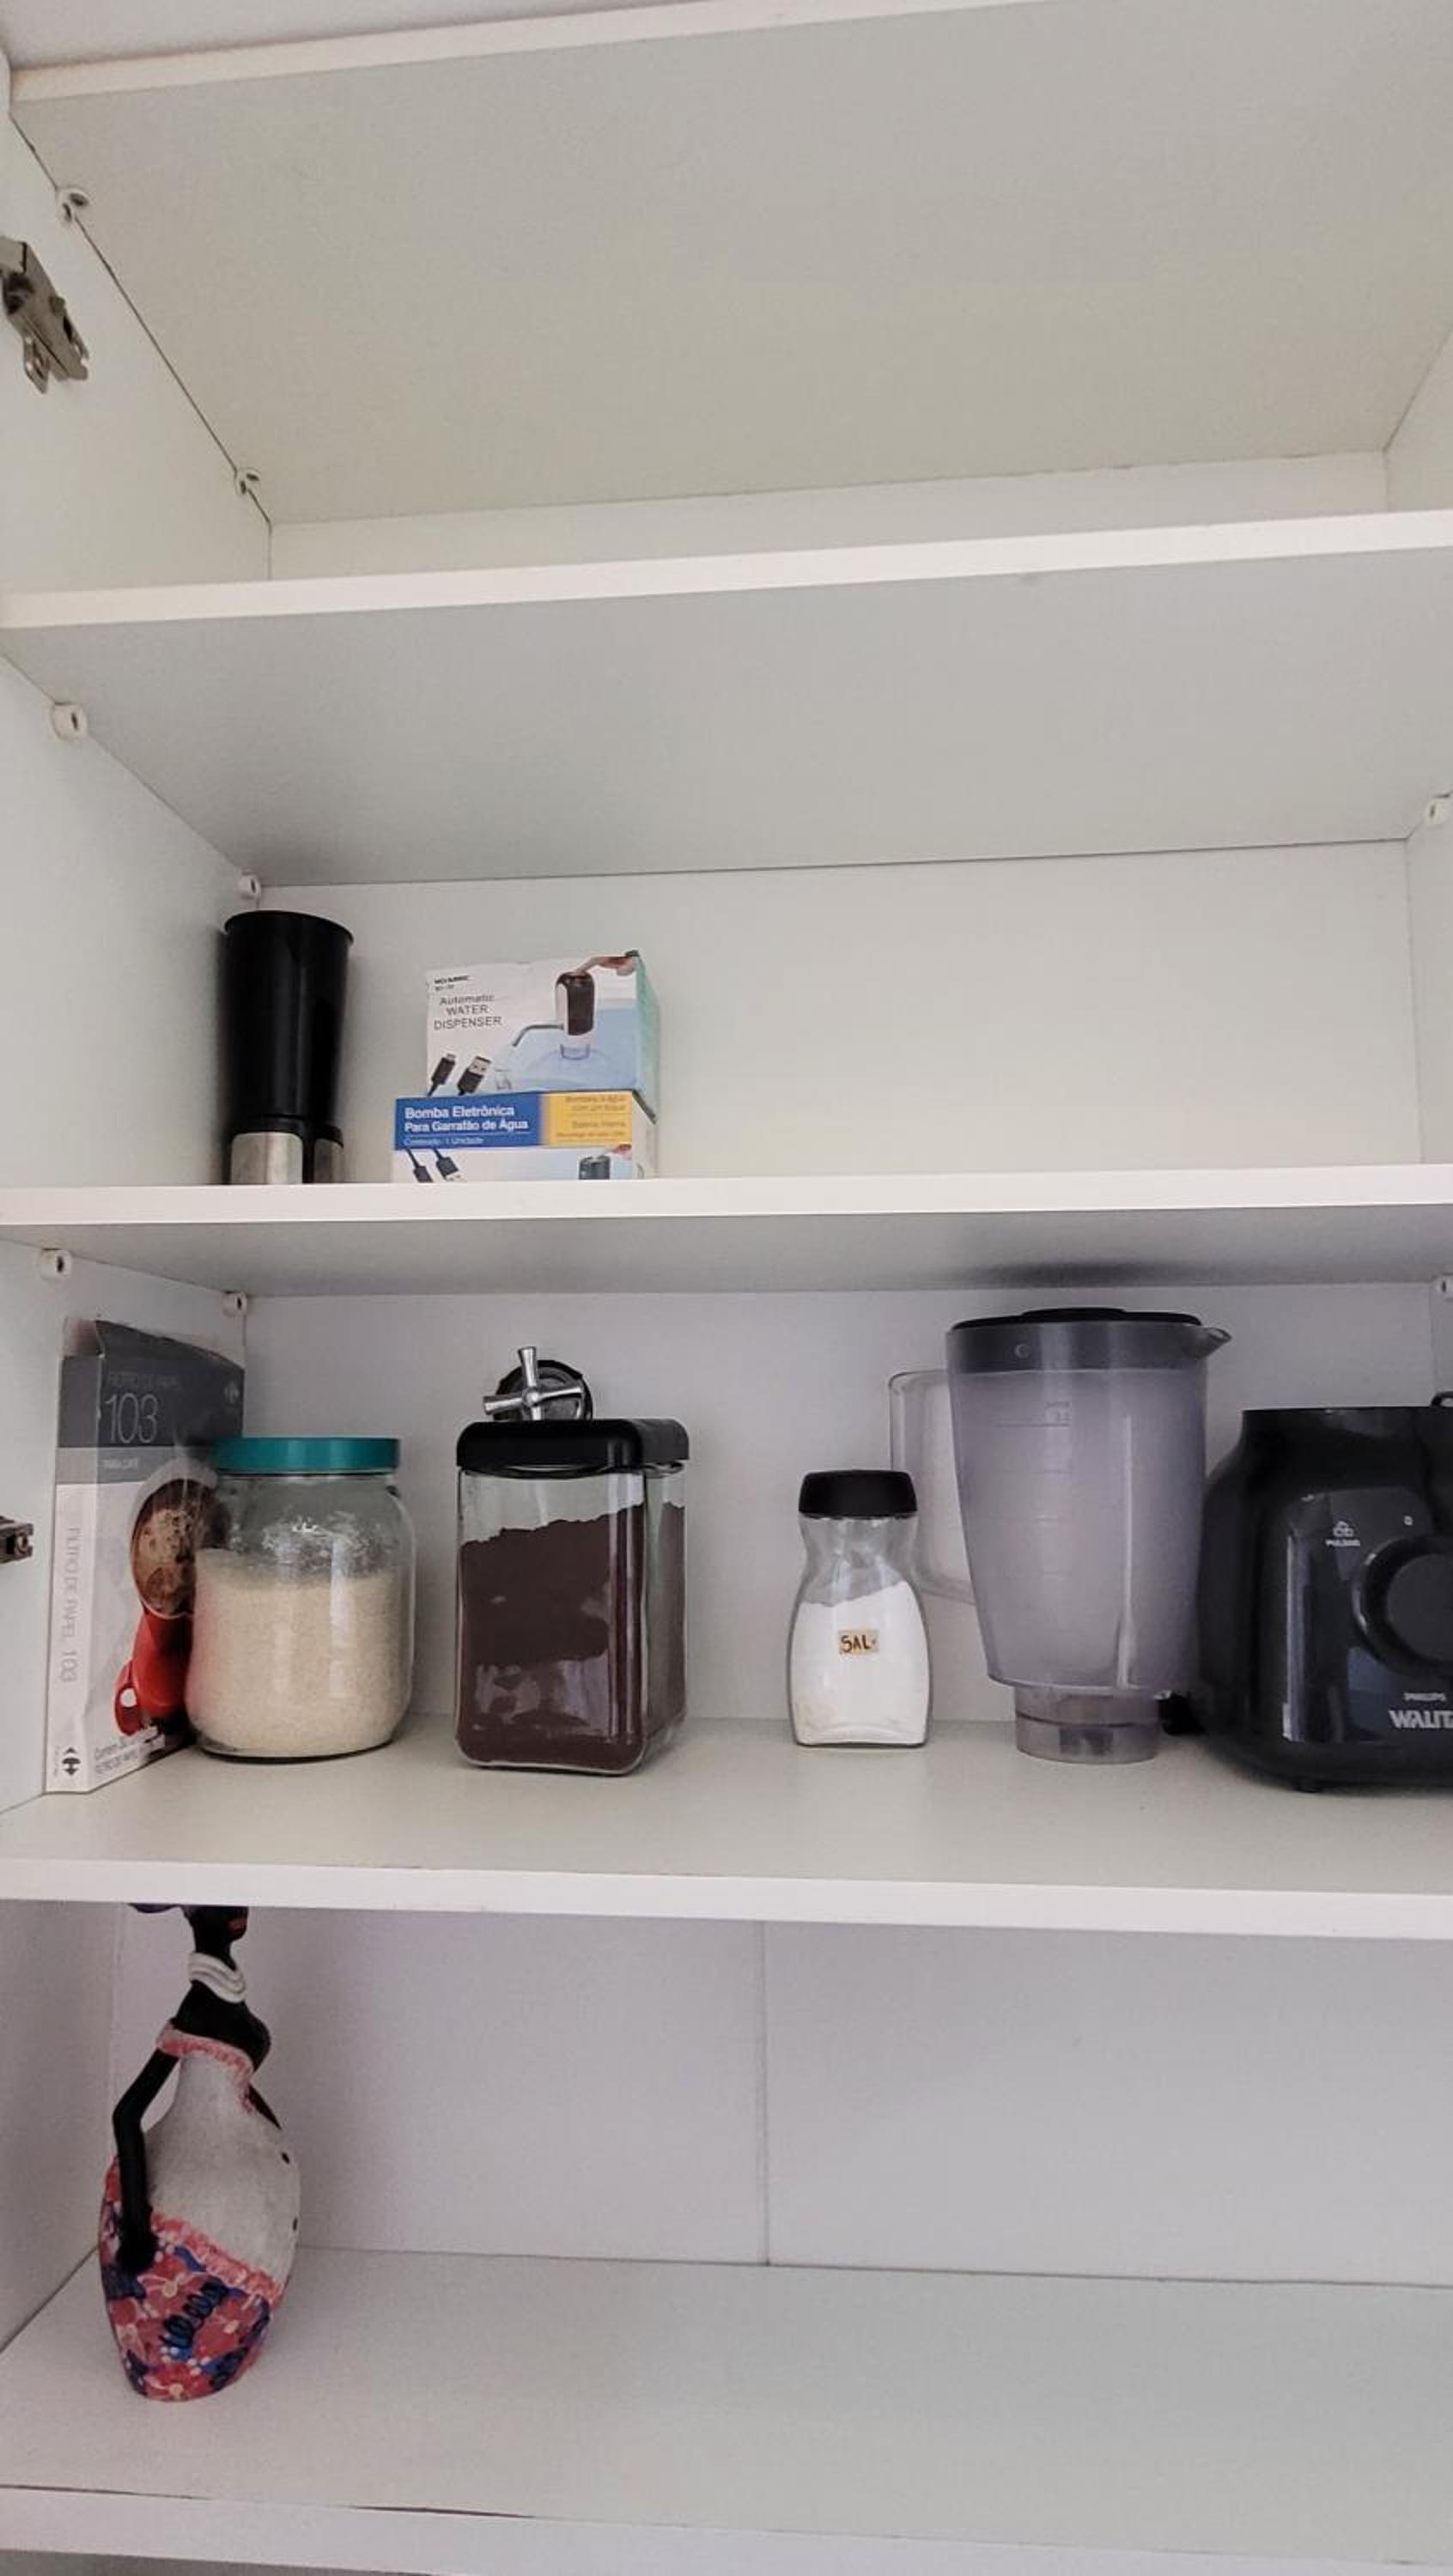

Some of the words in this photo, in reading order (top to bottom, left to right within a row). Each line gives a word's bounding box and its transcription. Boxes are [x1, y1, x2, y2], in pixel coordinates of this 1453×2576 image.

[446, 1005, 489, 1016] WATER
[434, 1016, 502, 1031] DISPENSER
[404, 1107, 449, 1119] Bomba
[453, 1104, 515, 1118] Eletrônica
[404, 1121, 430, 1133] Para
[432, 1119, 480, 1131] Garrafão
[482, 1119, 497, 1131] de
[499, 1117, 529, 1133] Água
[105, 1392, 159, 1444] 103
[64, 1577, 80, 1594] DE
[62, 1598, 79, 1638] PAPEL
[841, 1634, 872, 1653] SAL
[59, 1649, 79, 1683] 103
[1389, 1710, 1453, 1728] WALIT
